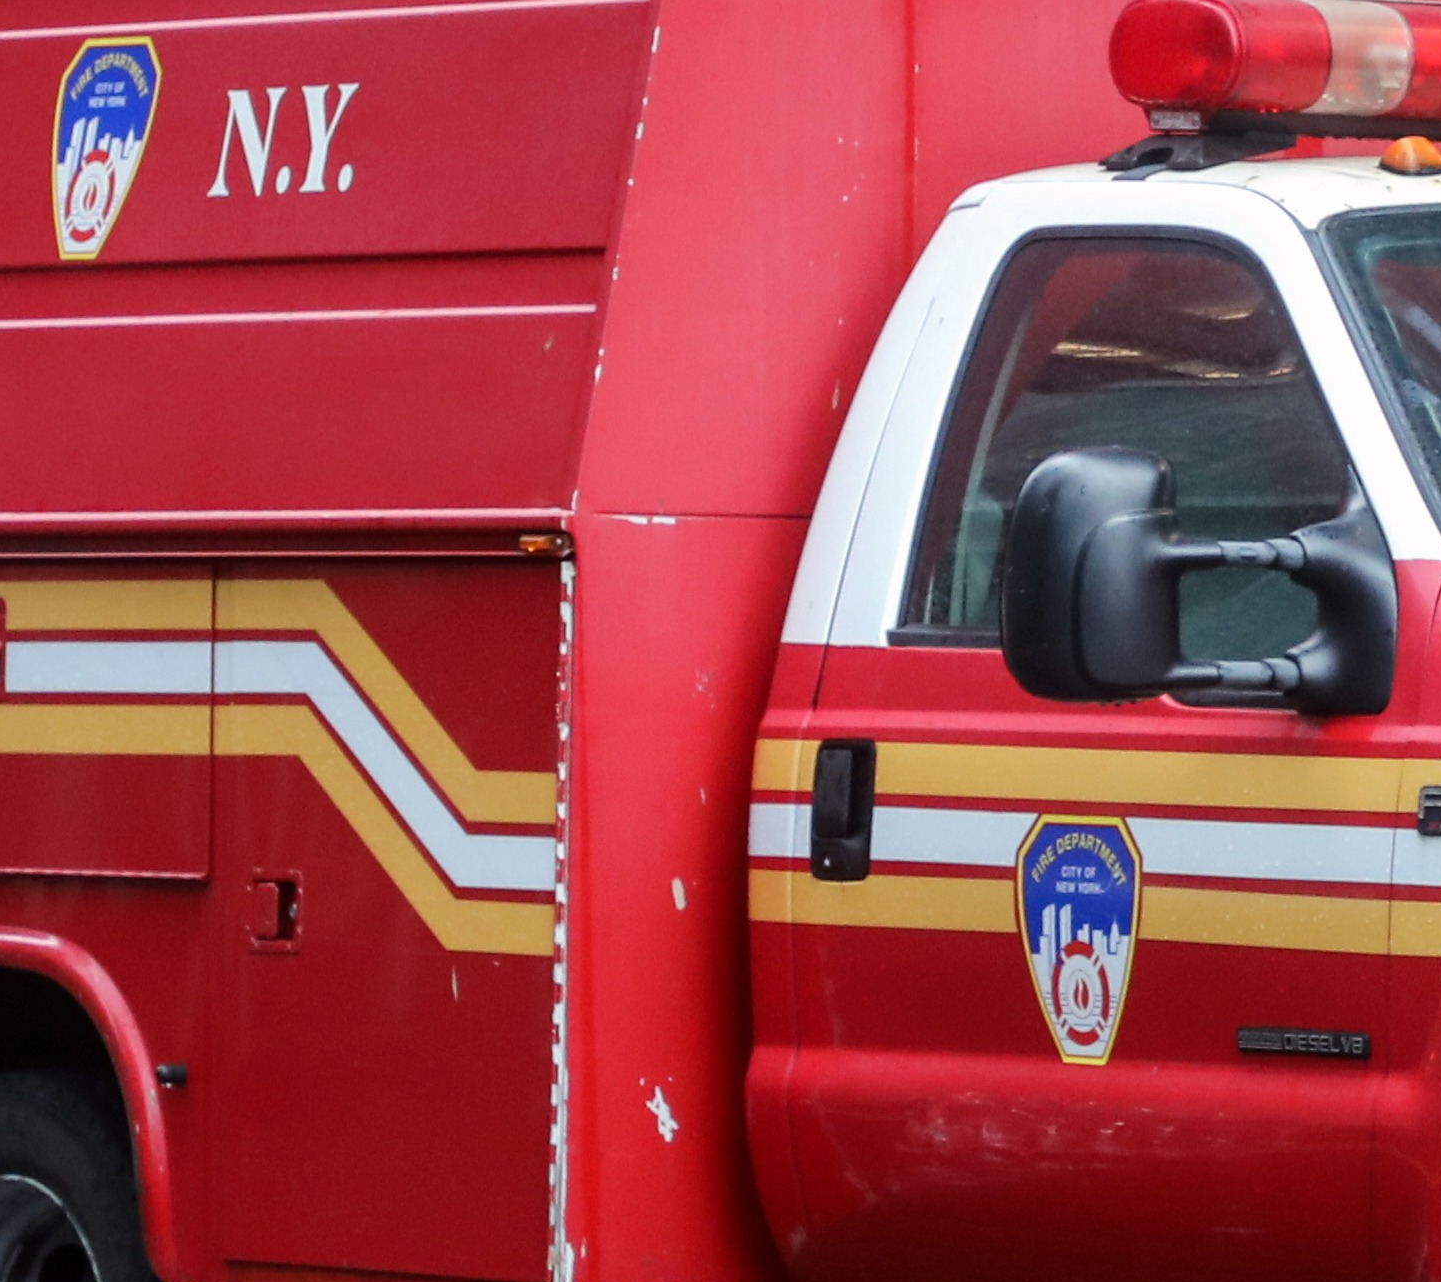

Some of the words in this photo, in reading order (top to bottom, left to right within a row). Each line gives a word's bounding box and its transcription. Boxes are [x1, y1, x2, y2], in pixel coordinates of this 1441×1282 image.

[207, 82, 360, 198] N.Y.
[1031, 845, 1057, 883] FIRE
[1056, 832, 1128, 887] DEPARTMENT
[1061, 865, 1083, 878] CITY
[1083, 865, 1097, 878] OF
[1056, 881, 1075, 894] NEW
